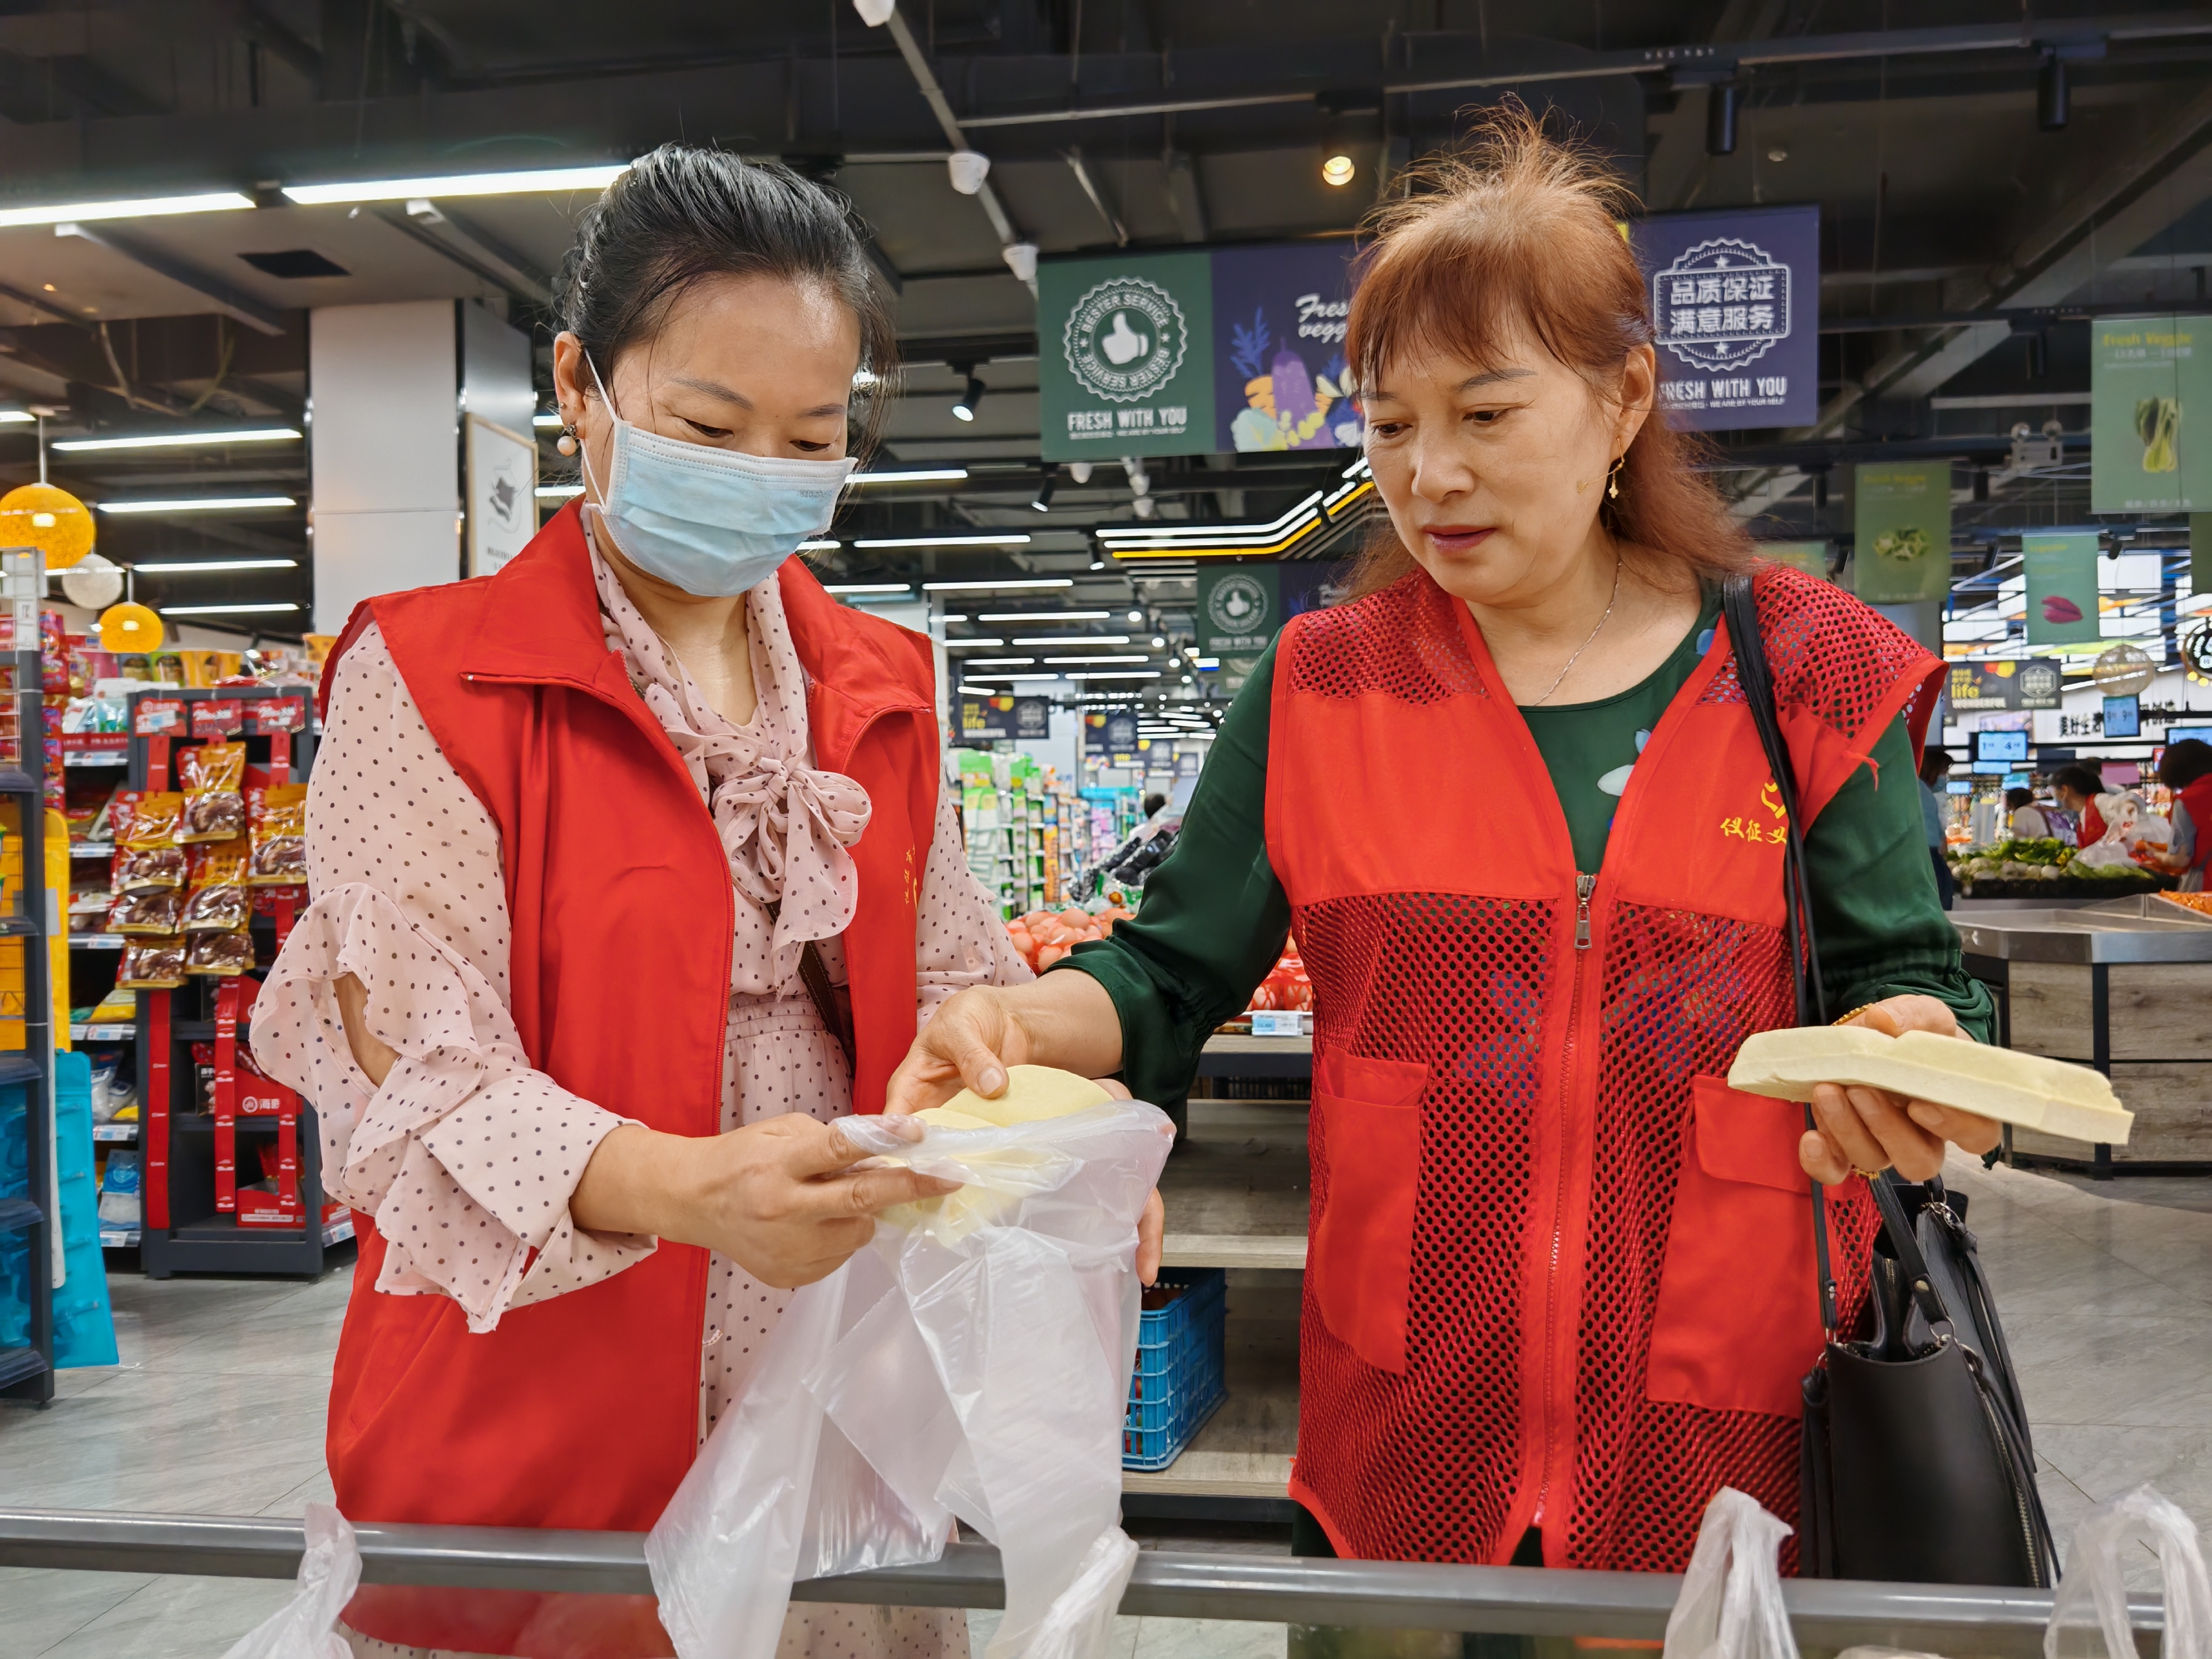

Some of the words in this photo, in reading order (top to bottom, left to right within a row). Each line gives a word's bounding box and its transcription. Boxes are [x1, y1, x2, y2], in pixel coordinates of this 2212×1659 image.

[1670, 275, 1776, 305] 品质保证
[1081, 295, 1122, 333] BESTER
[1123, 294, 1169, 328] SERVICE
[1295, 293, 1348, 323] Fres
[1670, 304, 1776, 335] 满意服务
[1298, 322, 1347, 344] vegg
[1711, 378, 1751, 399] WITH
[1756, 376, 1788, 397] YOU
[1067, 410, 1113, 431] FRESH
[1116, 408, 1154, 428] WITH
[1158, 407, 1187, 426] YOU
[1720, 817, 1787, 845] 仪征义
